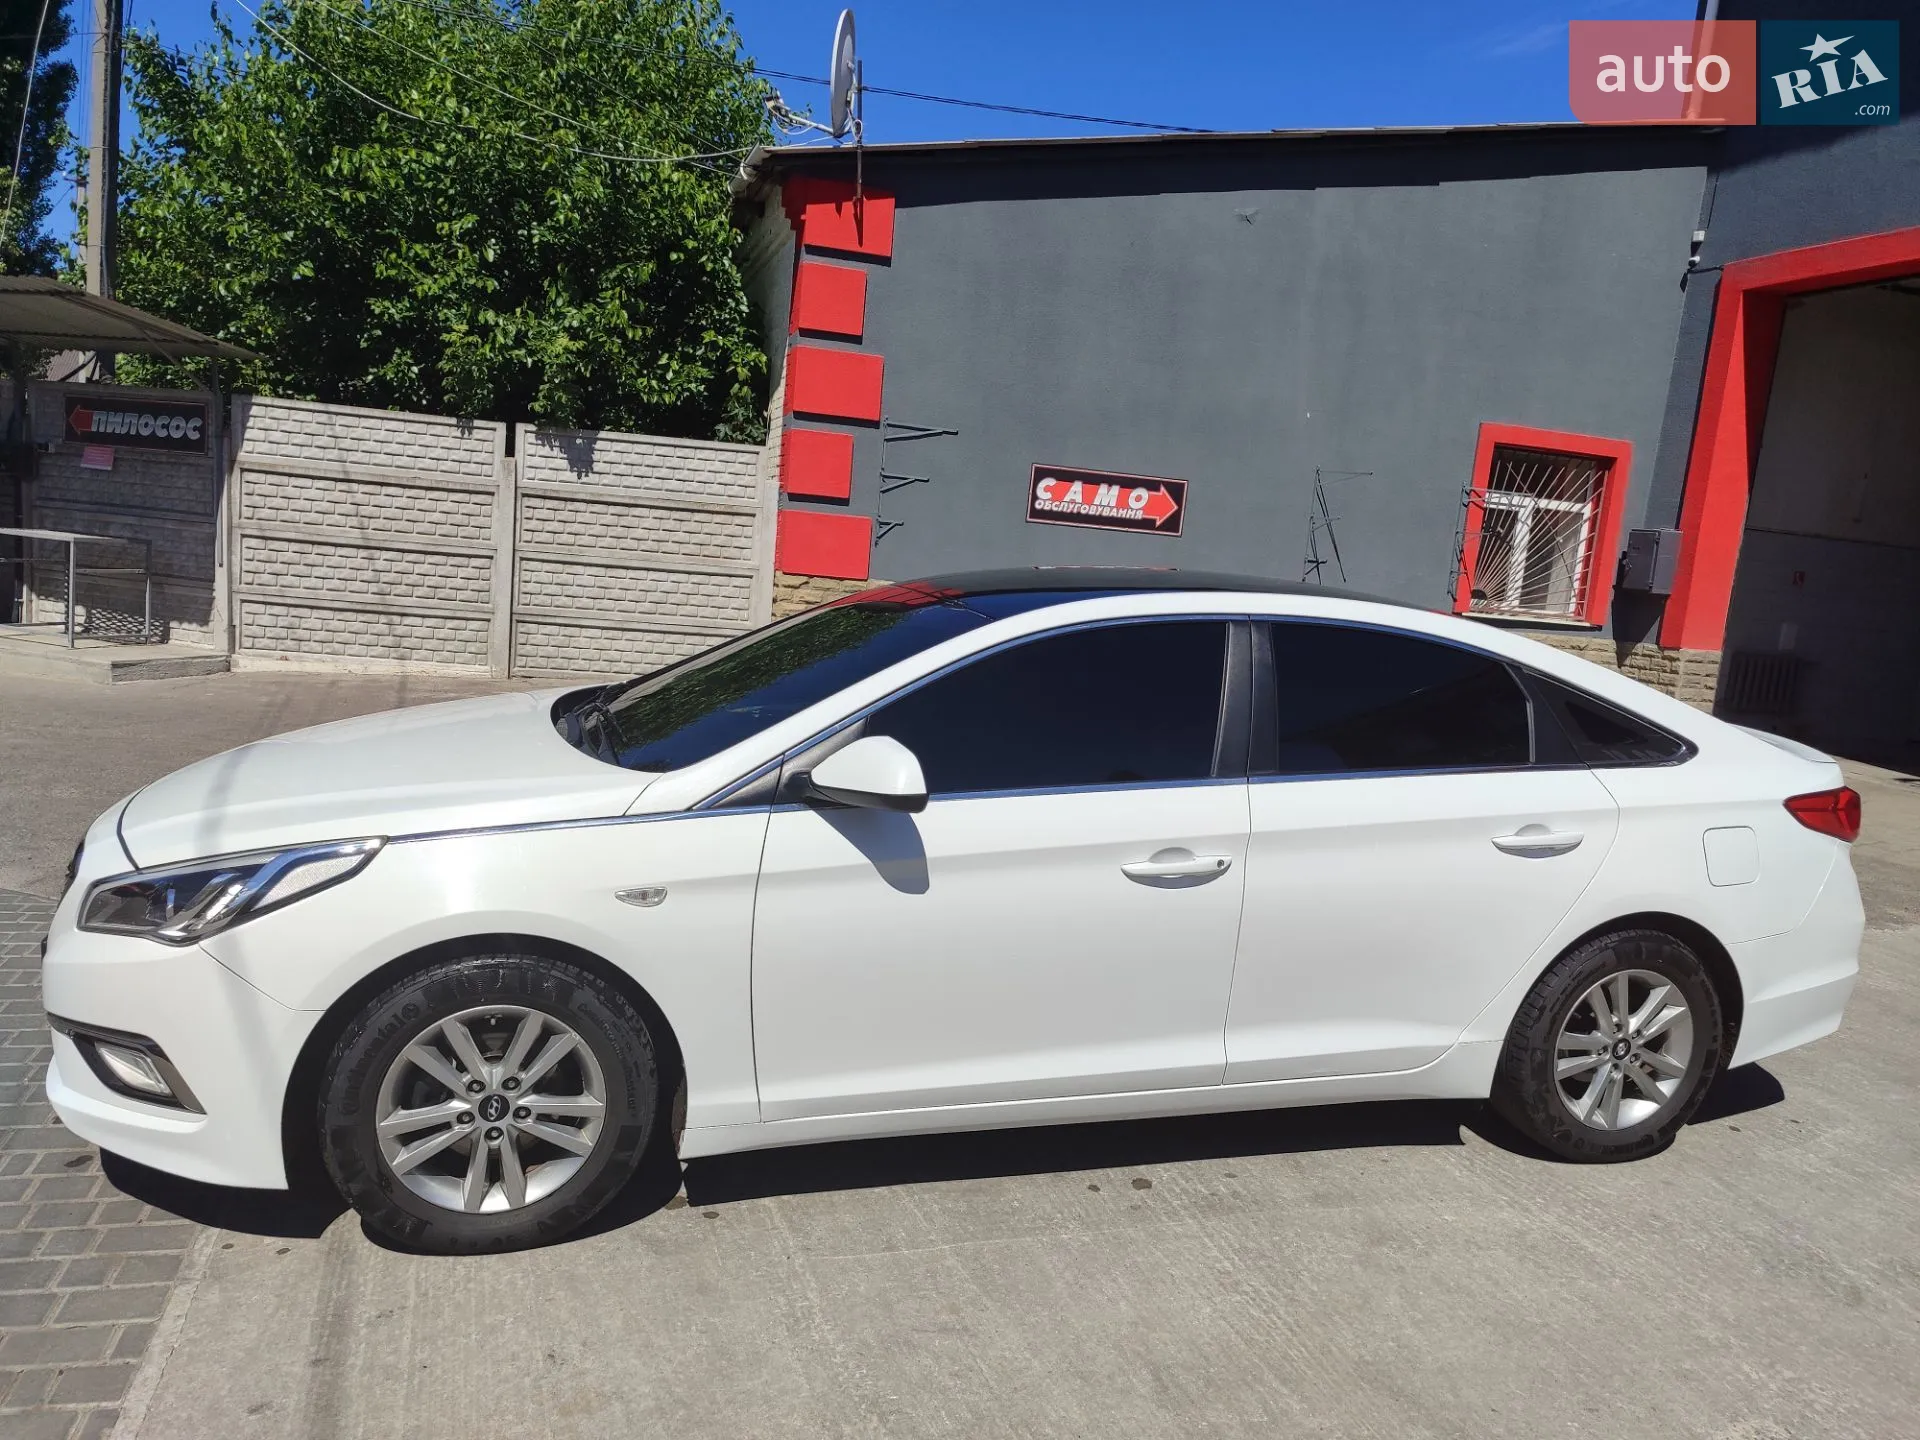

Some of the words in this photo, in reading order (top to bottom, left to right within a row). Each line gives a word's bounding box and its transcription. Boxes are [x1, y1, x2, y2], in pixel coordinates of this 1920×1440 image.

[91, 410, 203, 441] ПИЛОСОС
[1036, 477, 1149, 510] САМО
[1034, 499, 1144, 520] ОБСЛУГОВУВАННЯ
